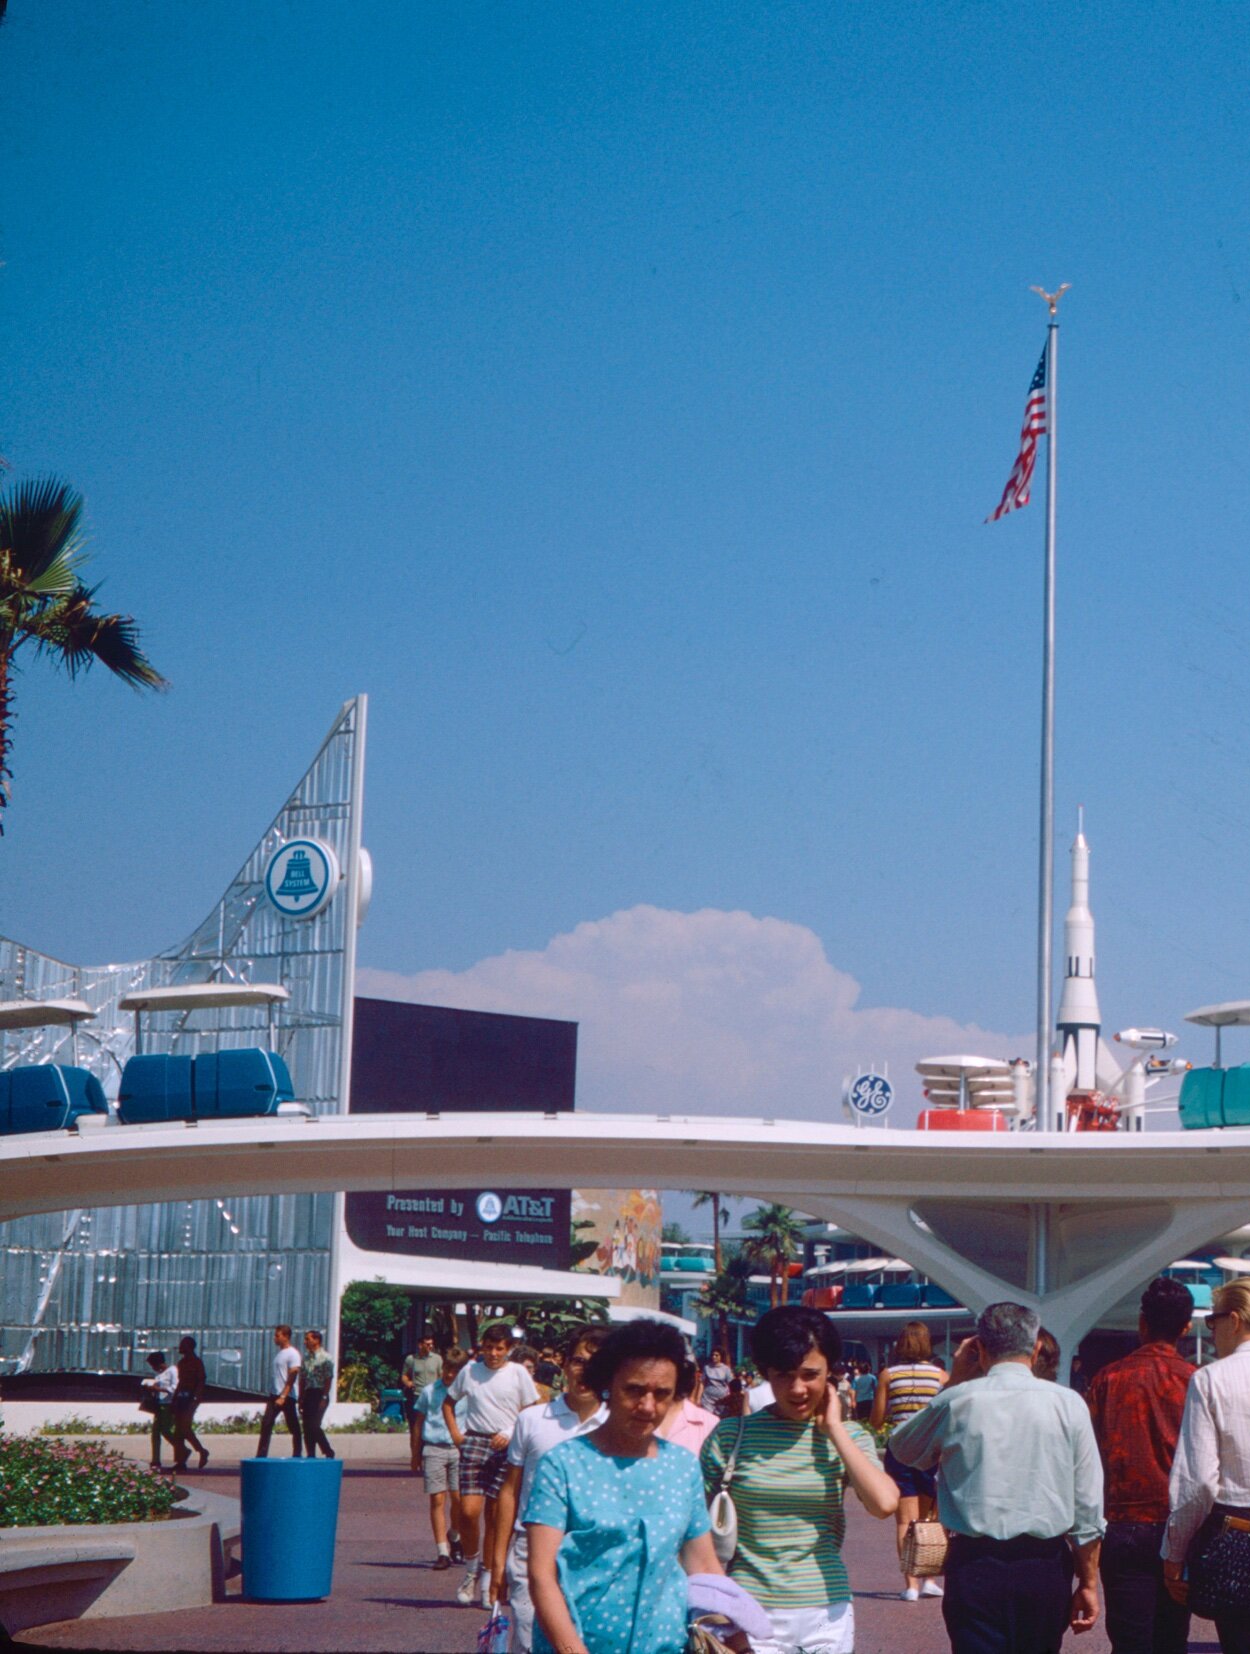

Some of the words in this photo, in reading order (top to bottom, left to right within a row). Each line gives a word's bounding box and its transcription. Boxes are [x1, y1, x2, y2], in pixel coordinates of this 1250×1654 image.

[386, 1194, 444, 1213] Presented
[450, 1199, 464, 1217] by
[503, 1194, 556, 1217] AT&T
[431, 1226, 467, 1242] Company
